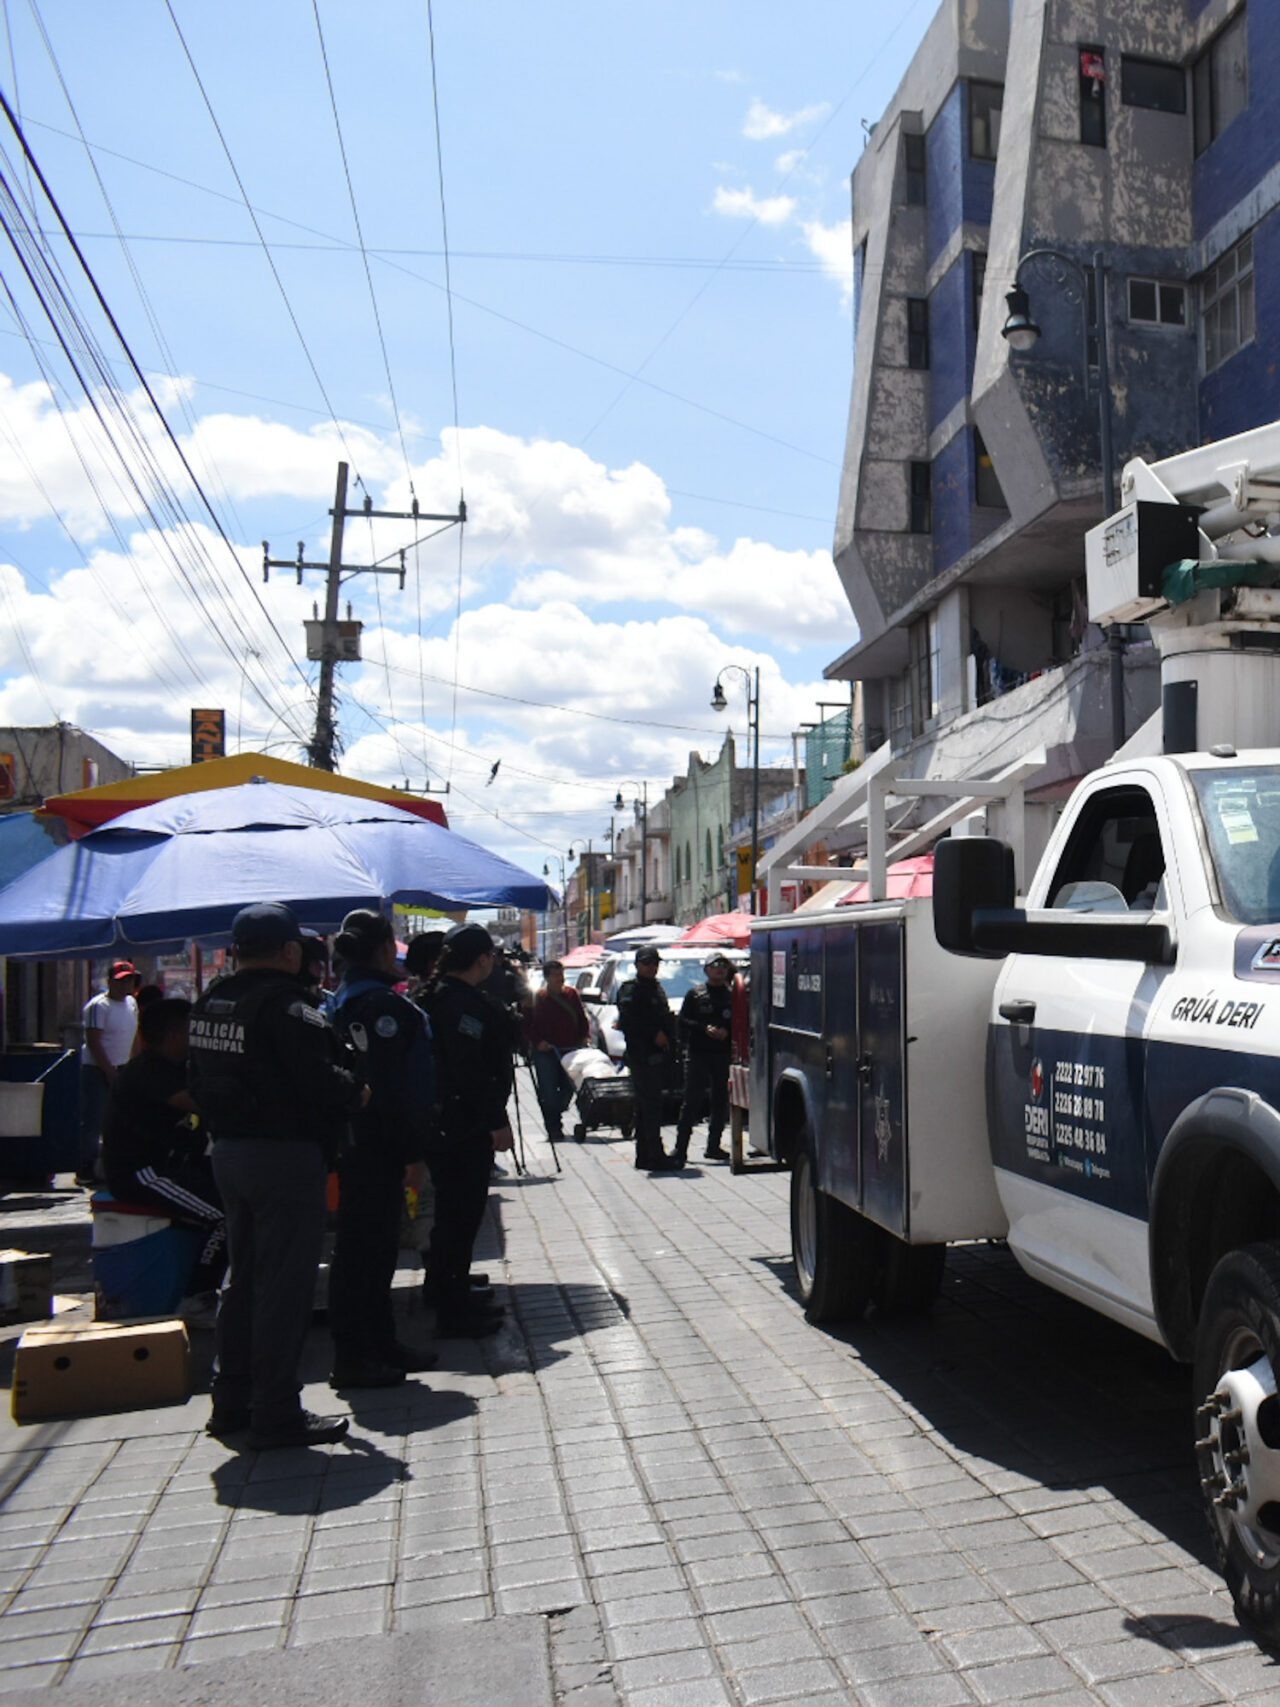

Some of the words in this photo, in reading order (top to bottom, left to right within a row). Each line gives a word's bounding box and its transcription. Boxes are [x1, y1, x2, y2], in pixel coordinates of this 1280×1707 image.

[1170, 989, 1218, 1024] GRÚA
[1215, 1000, 1266, 1029] DERI
[189, 1018, 245, 1041] POLICÍA
[188, 1034, 245, 1053] MUNICIPAL
[1073, 1062, 1083, 1086] 72
[1024, 1104, 1049, 1137] DERI
